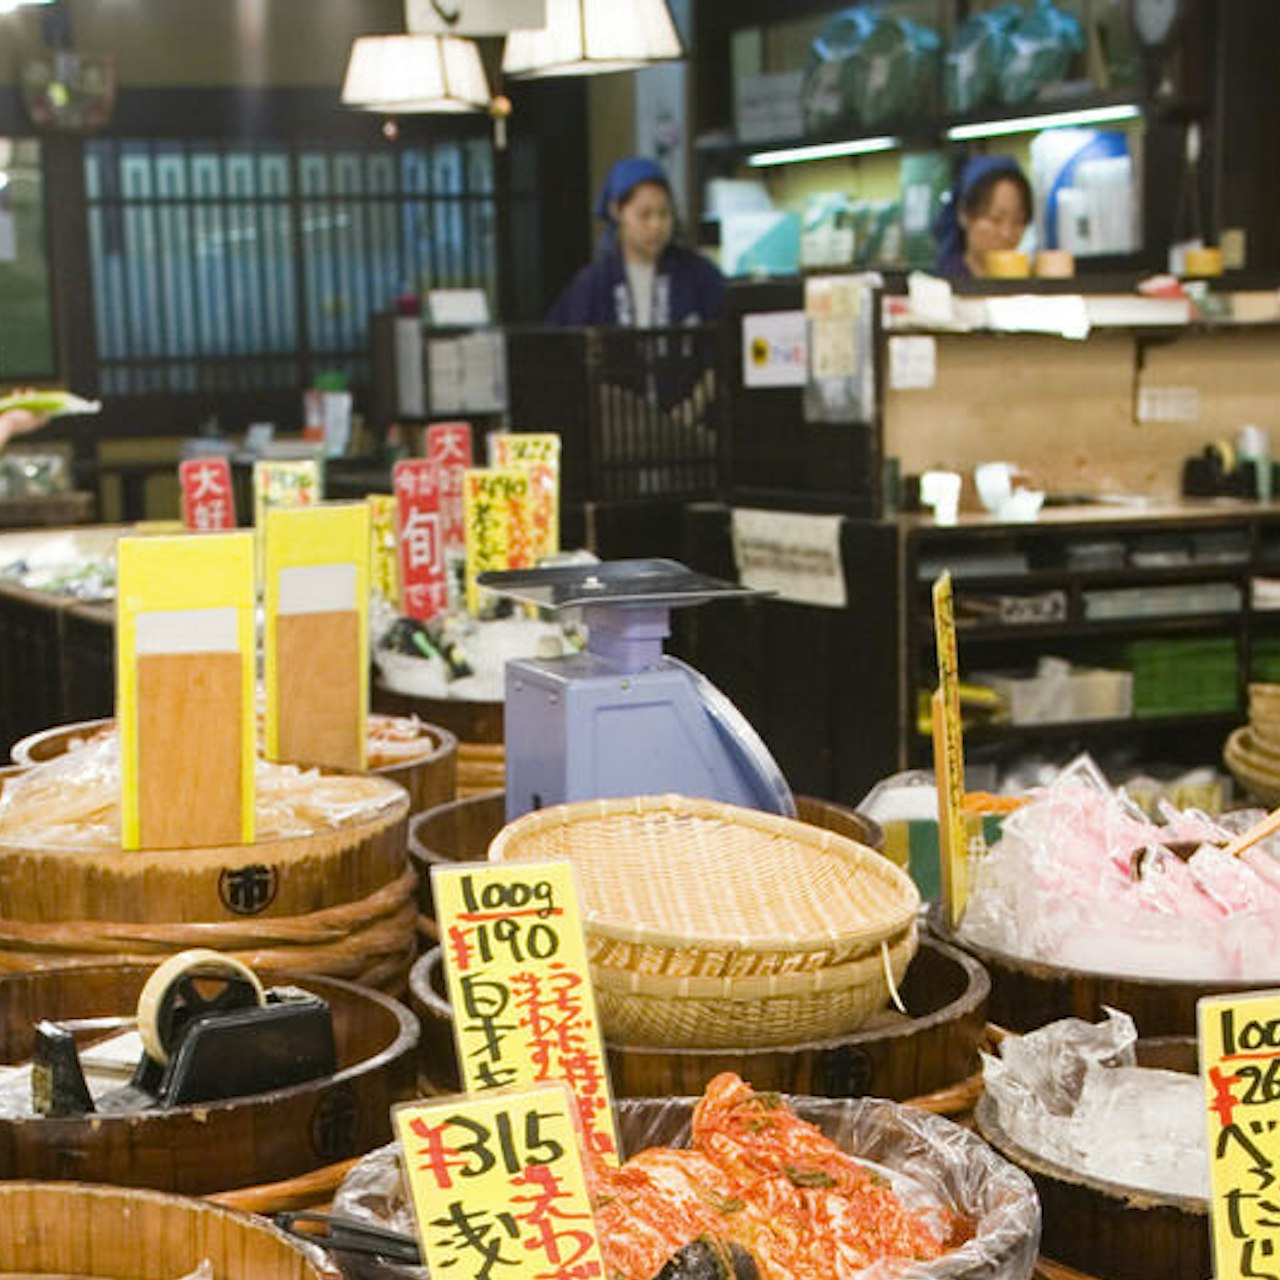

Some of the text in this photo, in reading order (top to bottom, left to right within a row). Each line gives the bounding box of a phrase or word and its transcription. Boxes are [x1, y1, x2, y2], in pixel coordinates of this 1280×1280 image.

[460, 875, 554, 920] 100g
[448, 918, 560, 970] ¥190
[408, 1109, 566, 1189] ¥315
